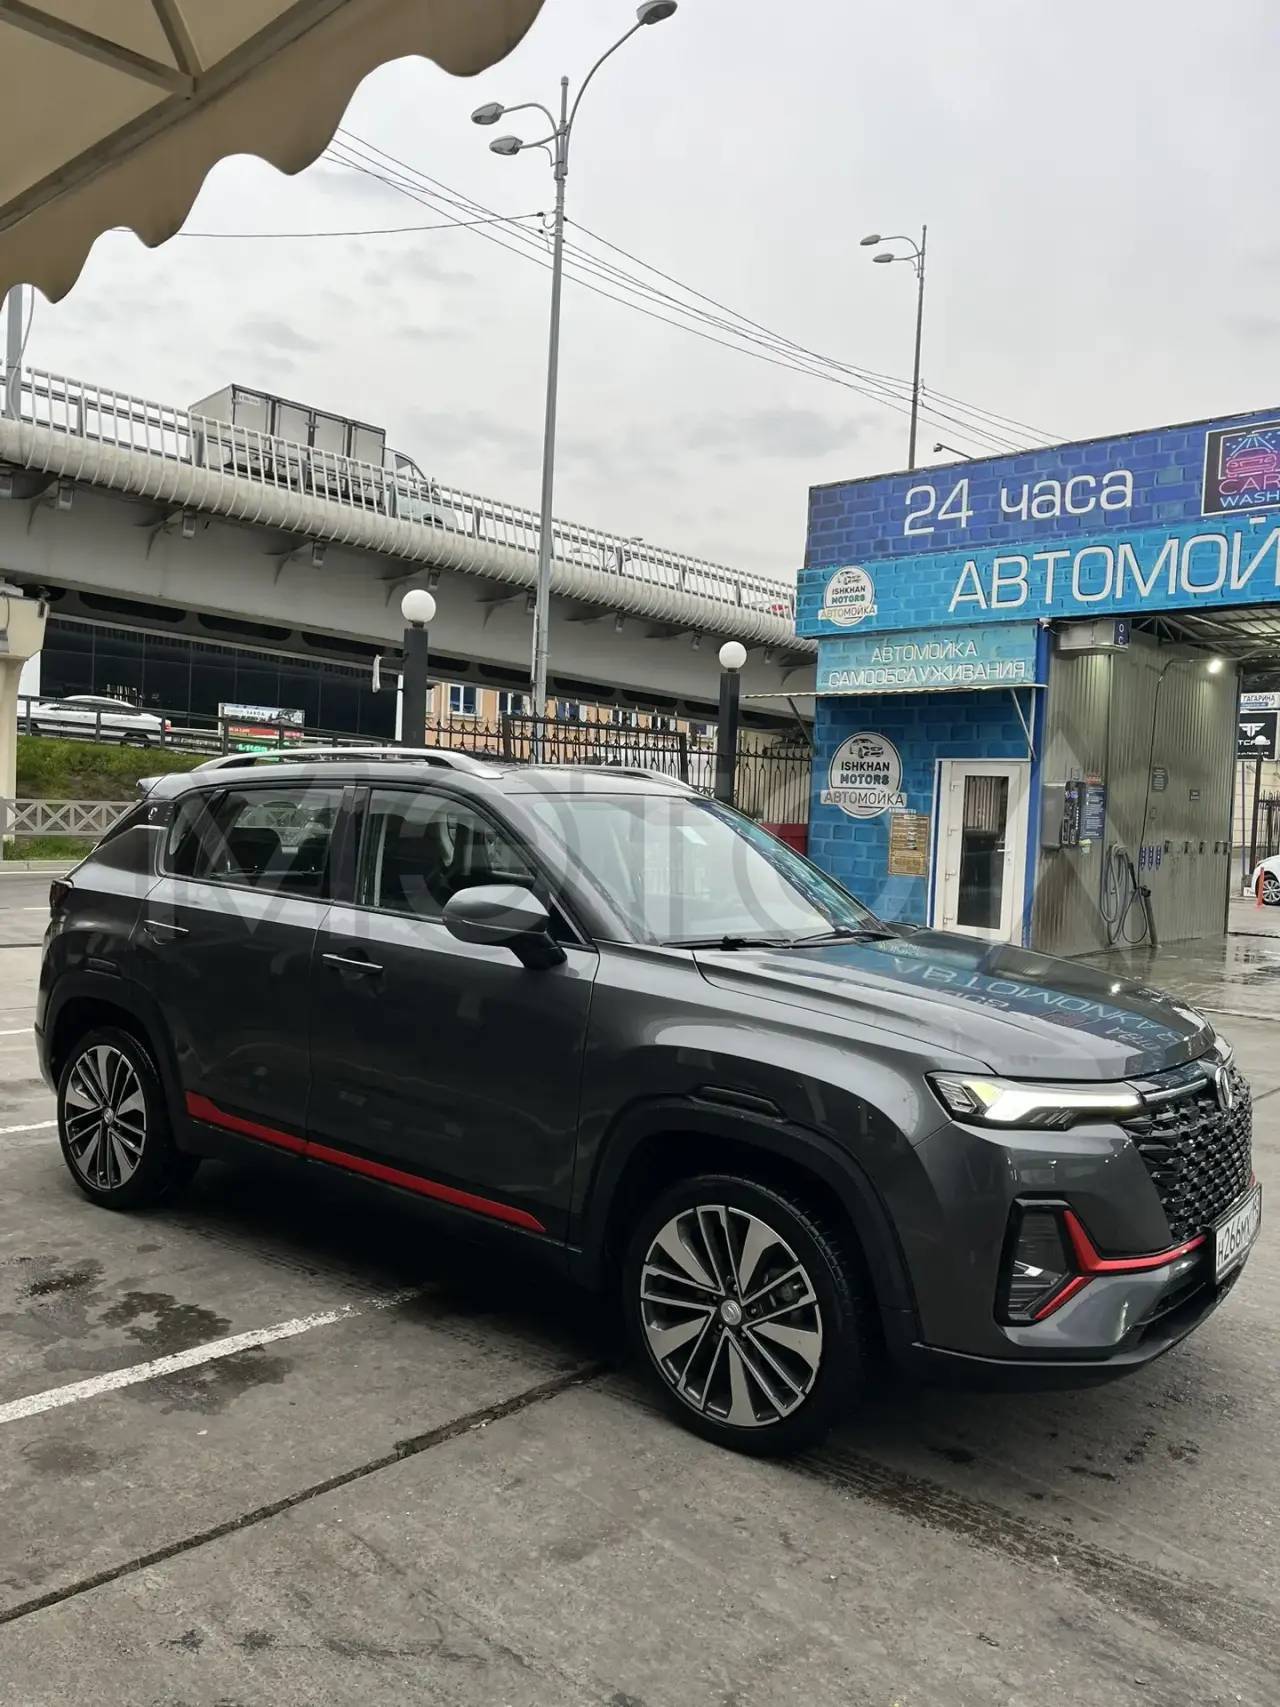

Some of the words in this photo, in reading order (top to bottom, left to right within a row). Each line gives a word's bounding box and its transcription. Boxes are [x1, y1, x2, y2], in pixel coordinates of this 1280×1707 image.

[1218, 473, 1280, 495] CAR
[903, 477, 974, 536] 24
[1000, 468, 1134, 521] часа
[1219, 490, 1280, 508] WASH
[832, 584, 866, 596] ISHKHAN
[831, 593, 866, 605] MOTORS
[821, 604, 876, 619] АВТОМОЙКА
[871, 639, 978, 663] АВТОМОЙКА
[828, 661, 1026, 689] САМООБСЛУЖИВАНИЯ
[840, 761, 890, 772] ISHKHAN
[840, 774, 890, 786] MOTORS
[823, 790, 905, 807] АВТОМОЙКА
